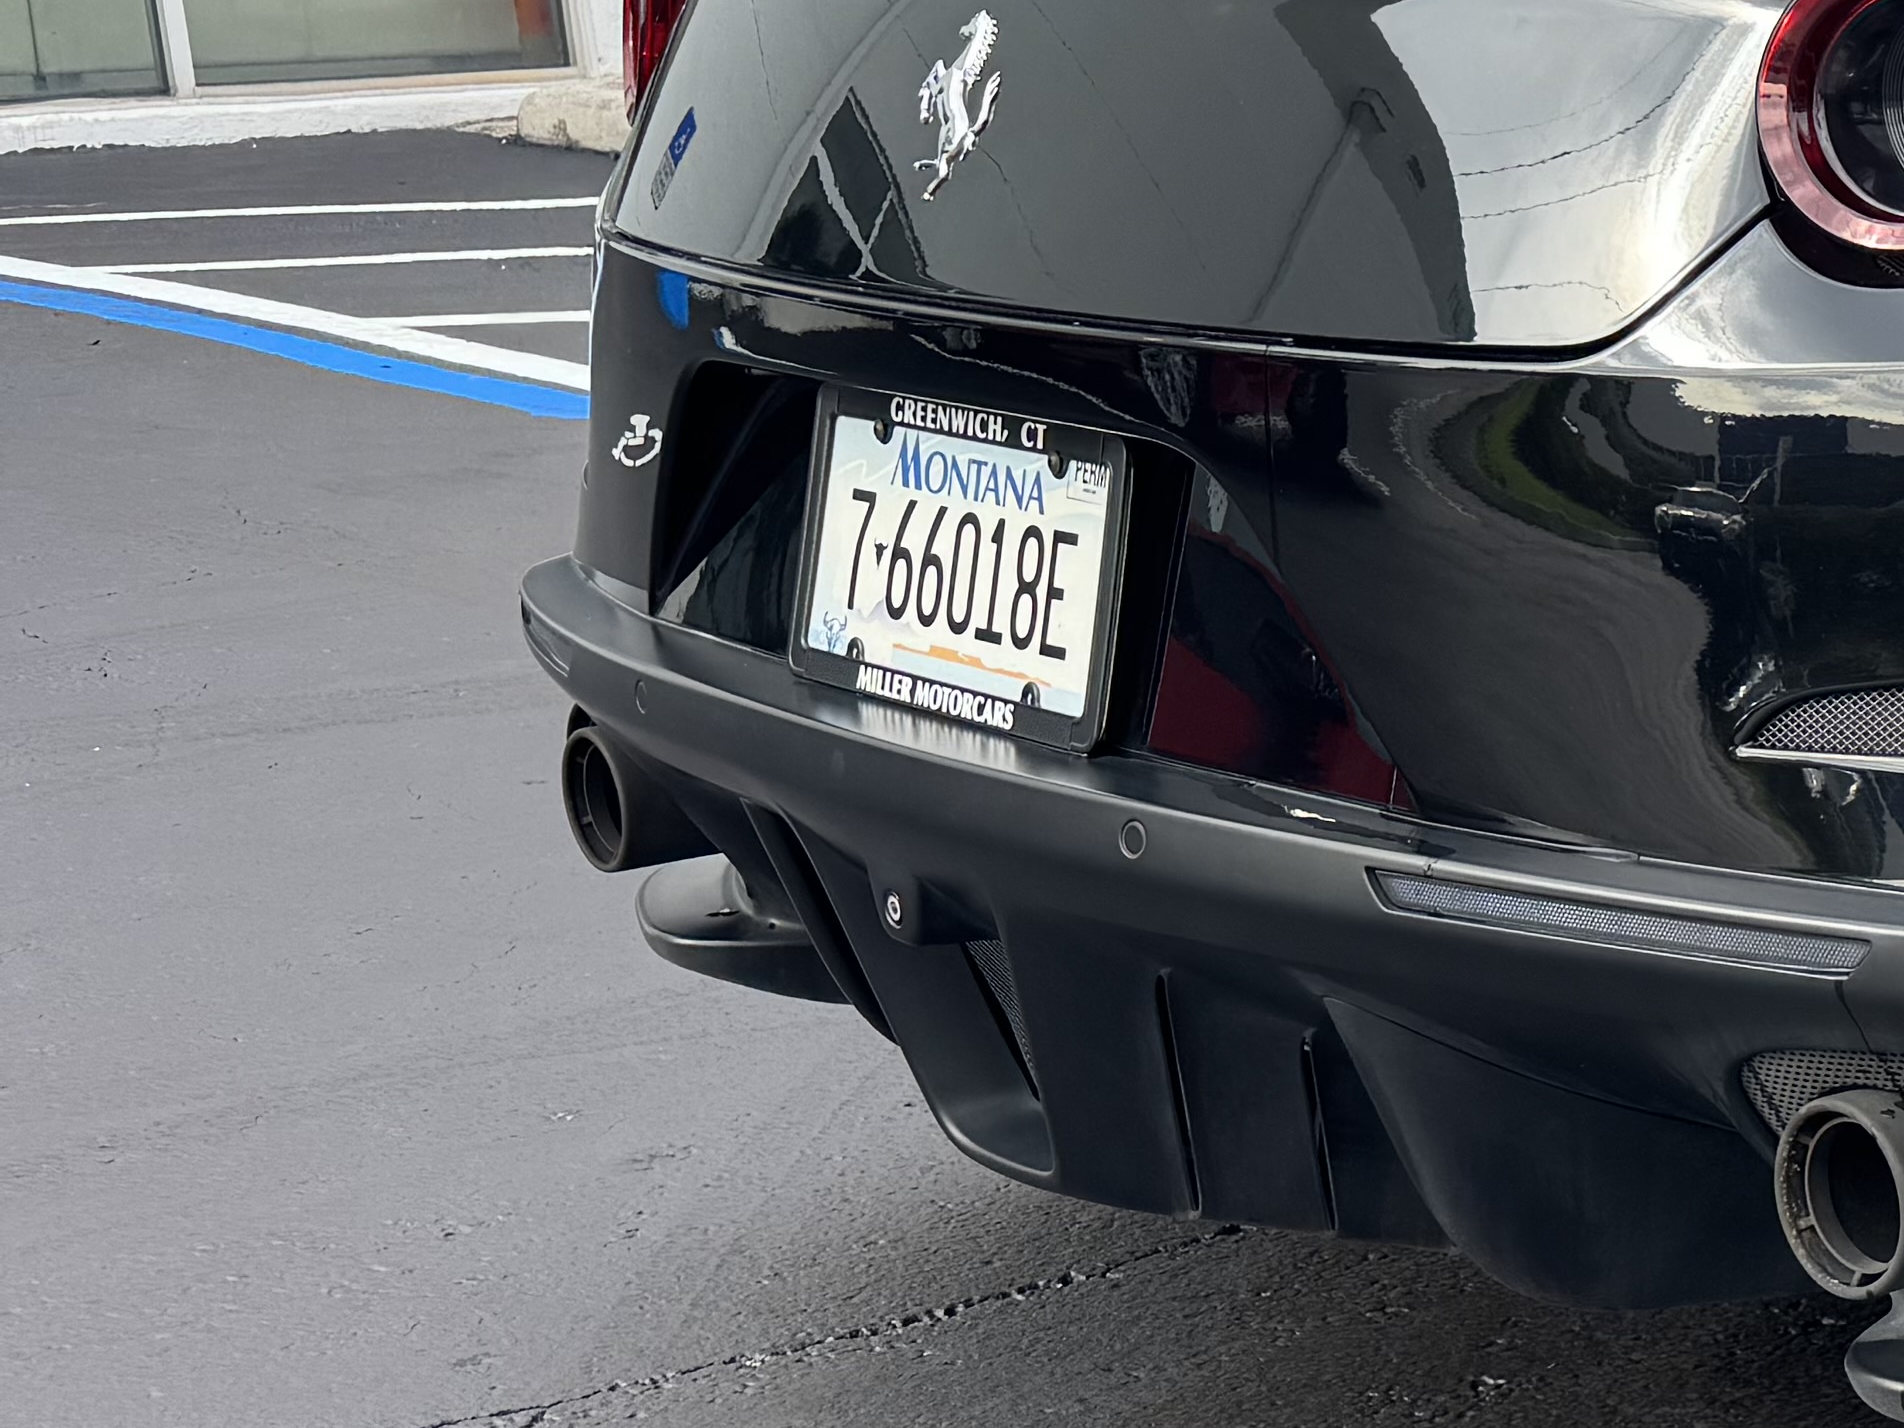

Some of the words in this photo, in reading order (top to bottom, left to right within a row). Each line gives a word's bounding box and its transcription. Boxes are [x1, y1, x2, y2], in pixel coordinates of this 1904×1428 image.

[890, 396, 1009, 443] GREENWICH,
[1020, 421, 1048, 450] CT
[856, 664, 913, 704] MILLER
[913, 684, 1015, 731] MOTORCARS
